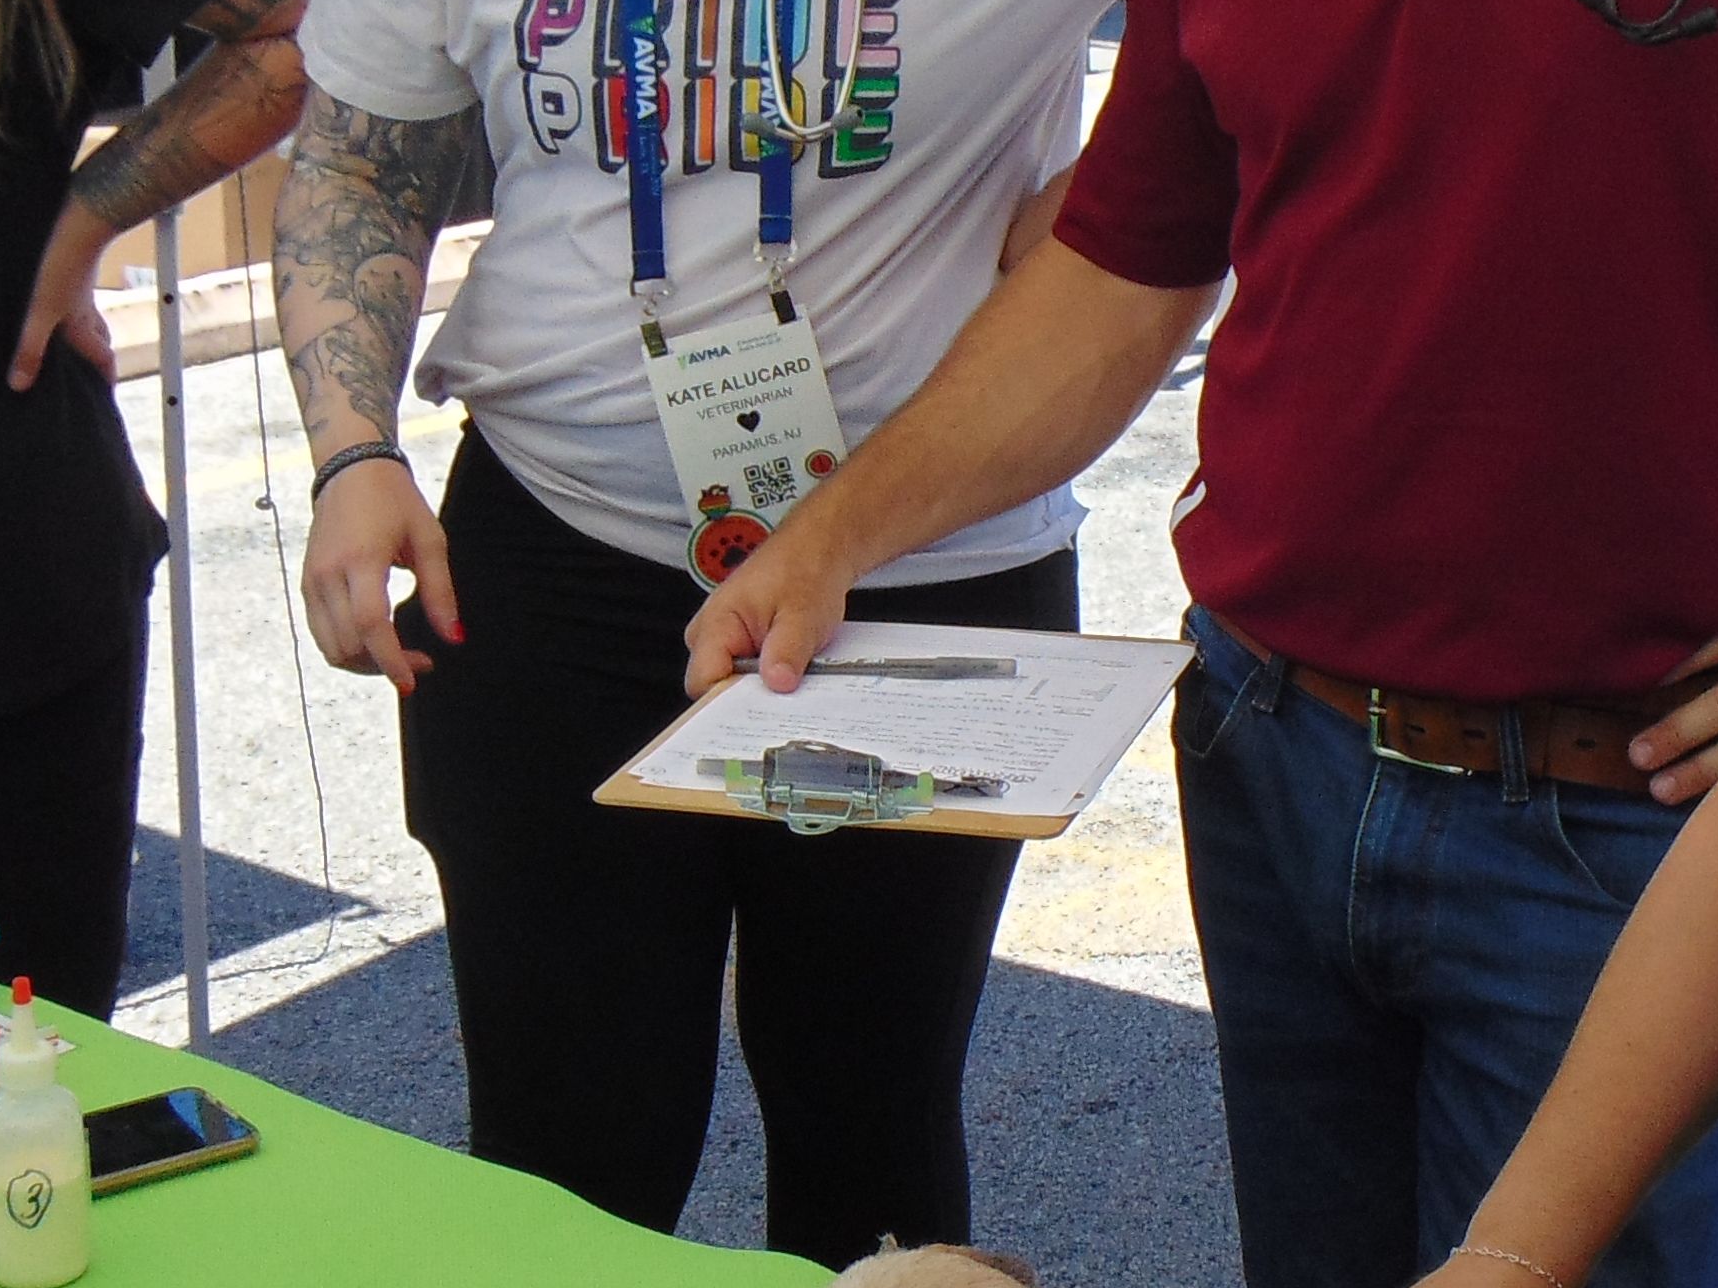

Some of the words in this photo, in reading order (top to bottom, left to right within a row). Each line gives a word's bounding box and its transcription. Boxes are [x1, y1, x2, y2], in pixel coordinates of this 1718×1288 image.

[631, 35, 658, 121] AVMA
[687, 343, 732, 366] AVMA
[665, 379, 718, 408] KATE
[720, 355, 811, 394] ALUCARD
[695, 385, 794, 422] VETERINARIAN
[711, 433, 781, 461] PARAMUS,
[783, 426, 803, 447] NJ
[20, 1182, 44, 1219] 3
